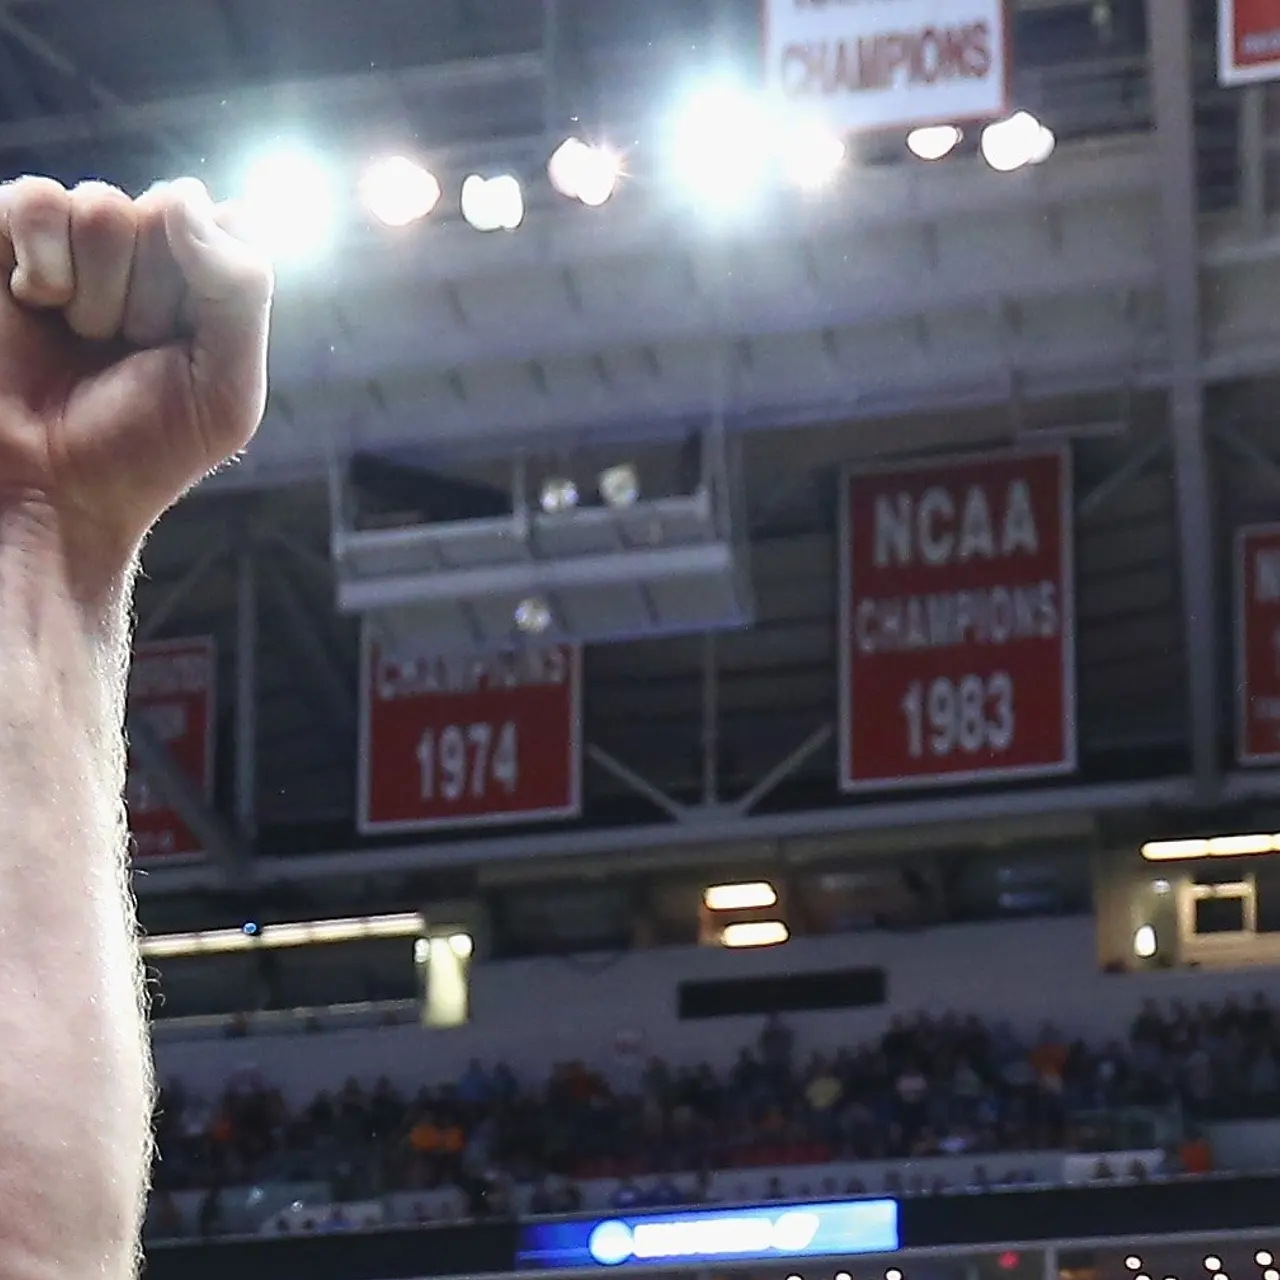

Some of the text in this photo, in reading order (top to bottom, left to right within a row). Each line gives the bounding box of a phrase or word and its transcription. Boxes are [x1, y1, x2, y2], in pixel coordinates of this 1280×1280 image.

[781, 21, 993, 97] CHAMPIONS
[874, 478, 1039, 568] NCAA
[856, 580, 1057, 654] CHAMPIONS
[902, 671, 1014, 758] 1983
[417, 719, 518, 801] 1974
